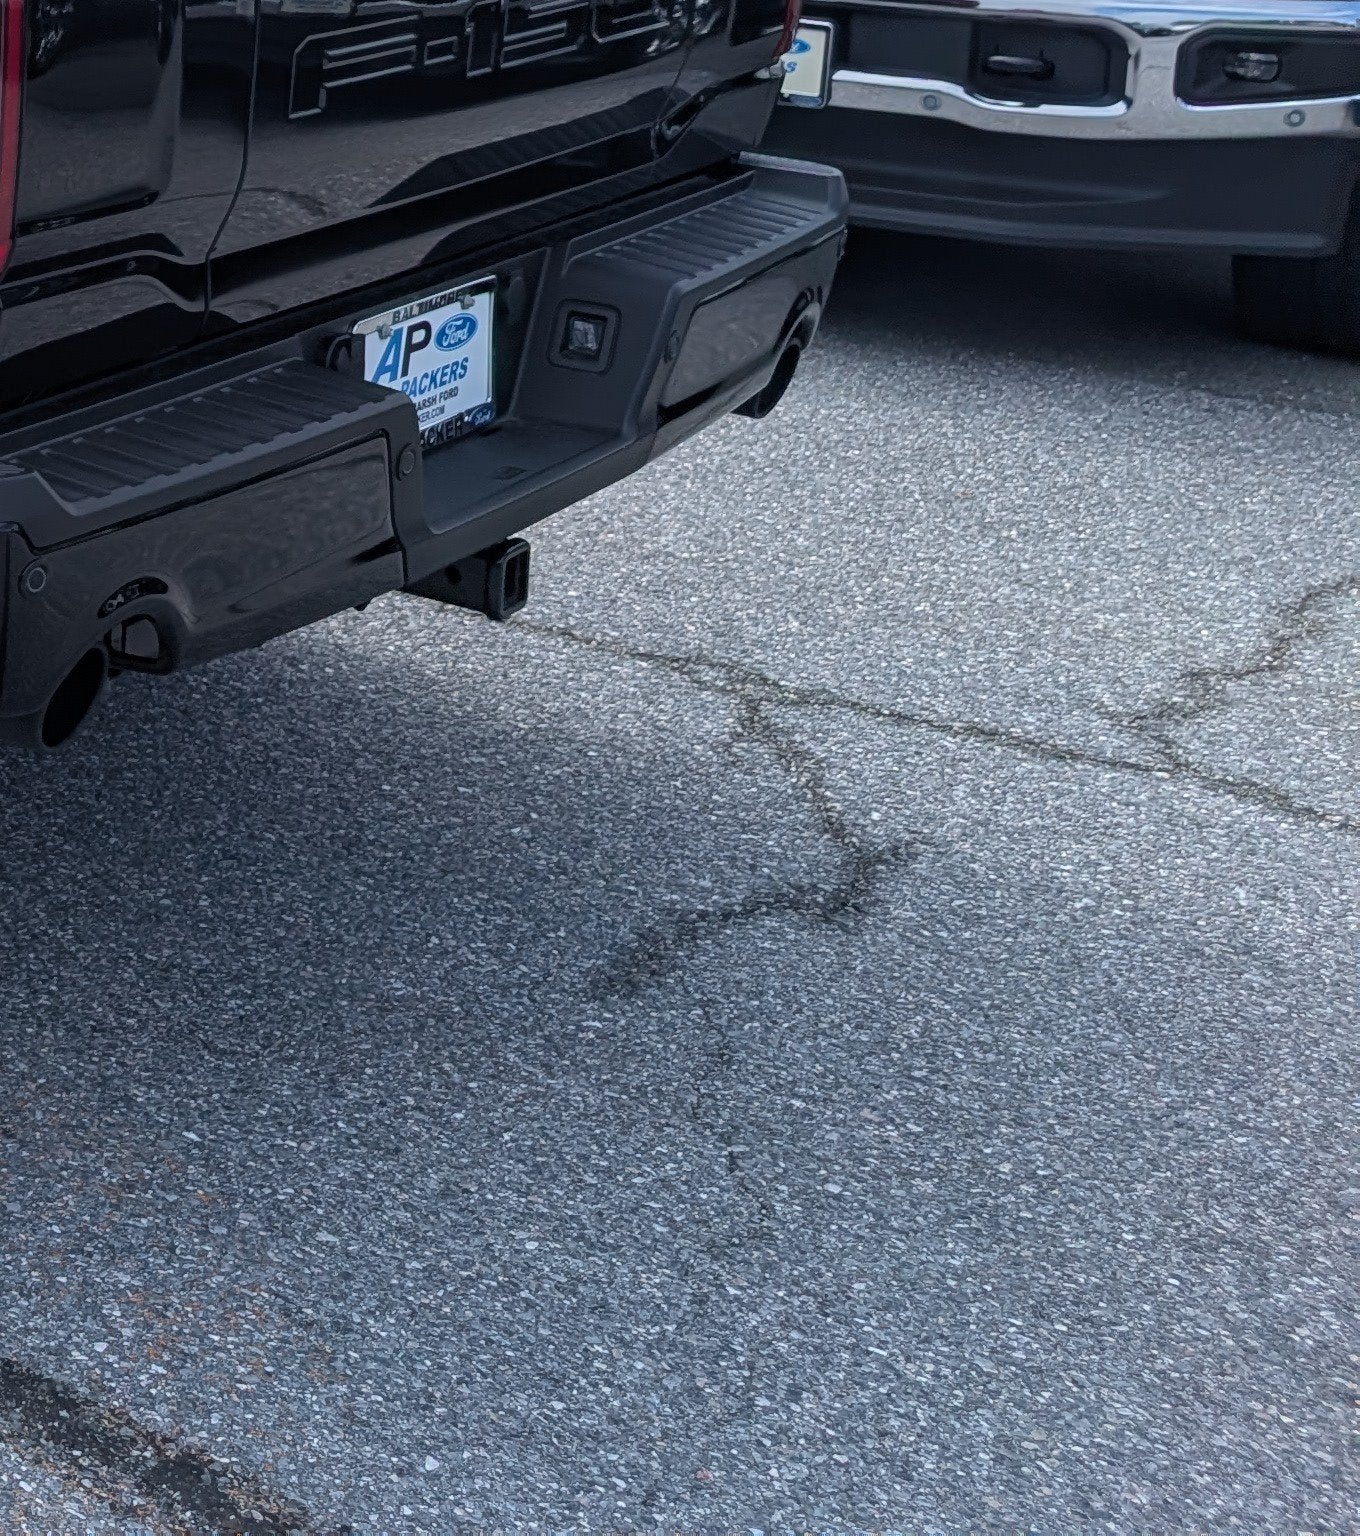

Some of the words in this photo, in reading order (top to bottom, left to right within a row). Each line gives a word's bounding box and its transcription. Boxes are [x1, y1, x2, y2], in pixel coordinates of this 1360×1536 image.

[440, 317, 471, 348] Ford
[371, 320, 432, 384] AP
[400, 356, 469, 399] PACKERS
[415, 394, 437, 411] ARSH
[439, 386, 459, 403] FORD
[419, 412, 464, 448] ACKER
